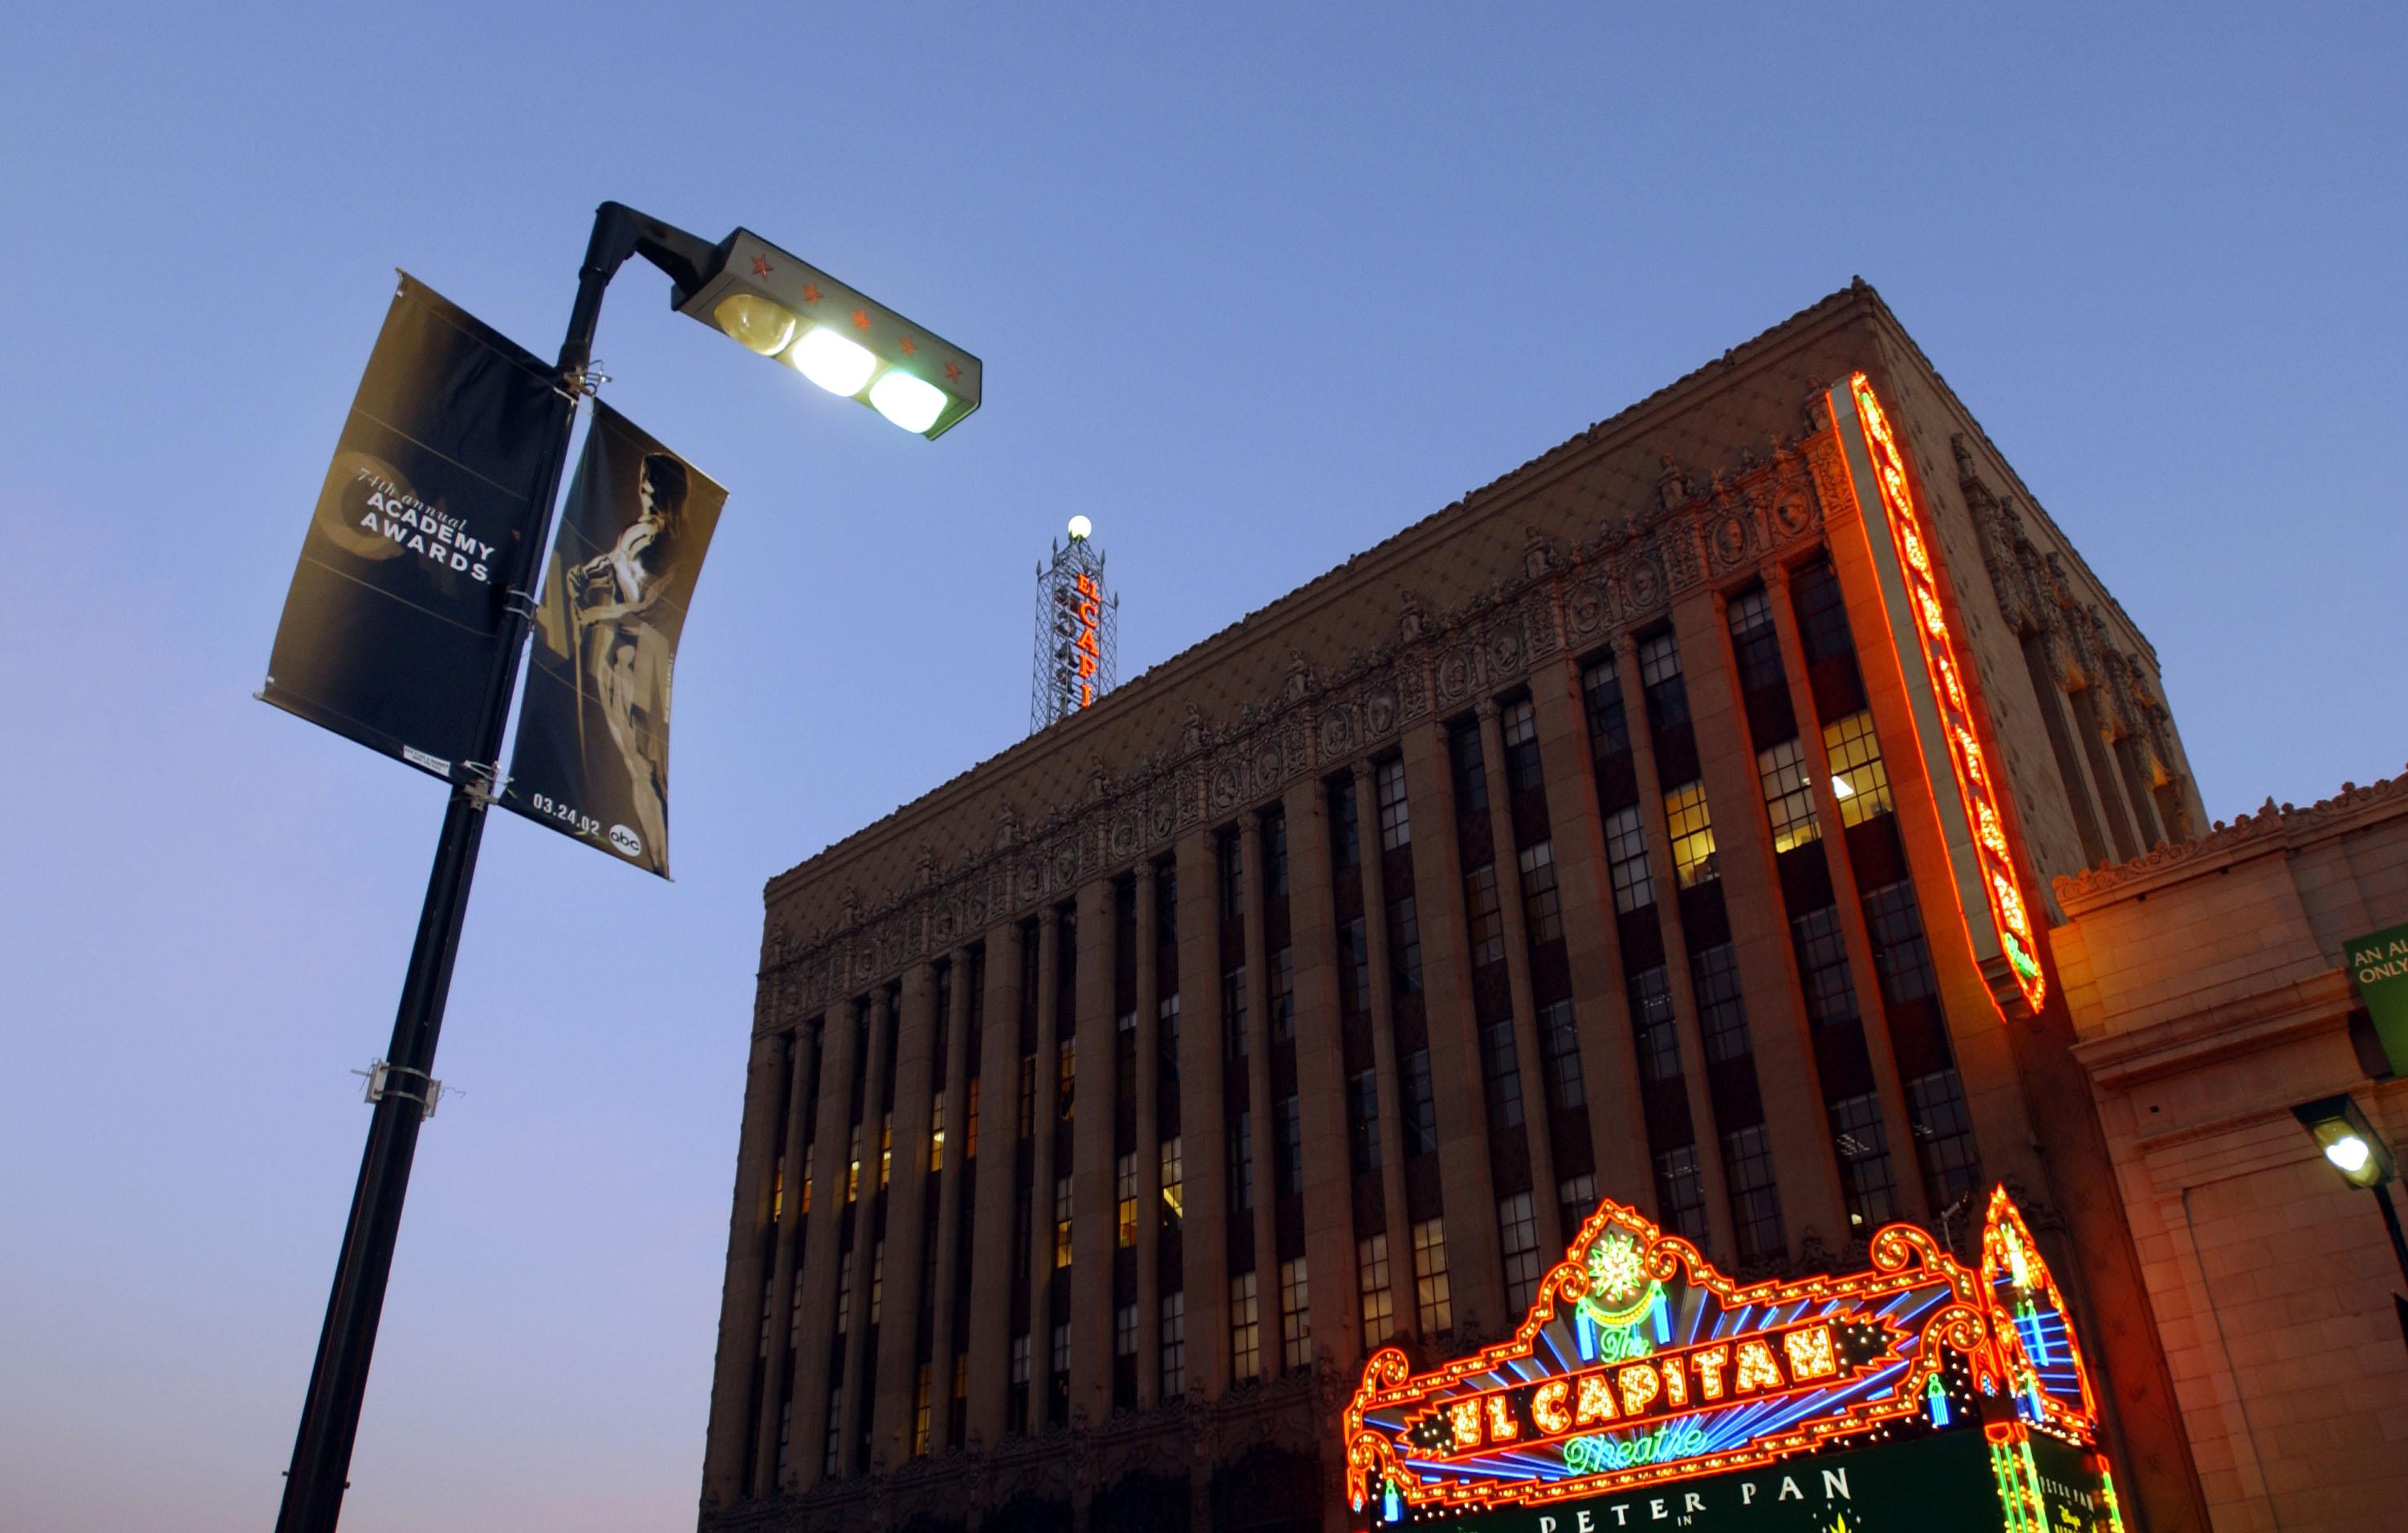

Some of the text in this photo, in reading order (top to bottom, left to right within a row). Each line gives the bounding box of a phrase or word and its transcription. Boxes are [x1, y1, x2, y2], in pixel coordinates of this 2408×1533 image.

[357, 467, 468, 531] 74th annual
[367, 491, 494, 561] ACADEMY
[1077, 574, 1101, 604] EL
[533, 793, 600, 836] 03.24.02
[610, 832, 641, 851] abc
[2355, 947, 2383, 967] AN
[2360, 958, 2408, 983] ONLY
[1601, 1326, 1653, 1364] The
[1451, 1324, 1837, 1450] EL CAPITAN
[1564, 1425, 1708, 1476] Theatre
[1540, 1467, 1852, 1533] PETER PAN
[1678, 1515, 1694, 1527] IN
